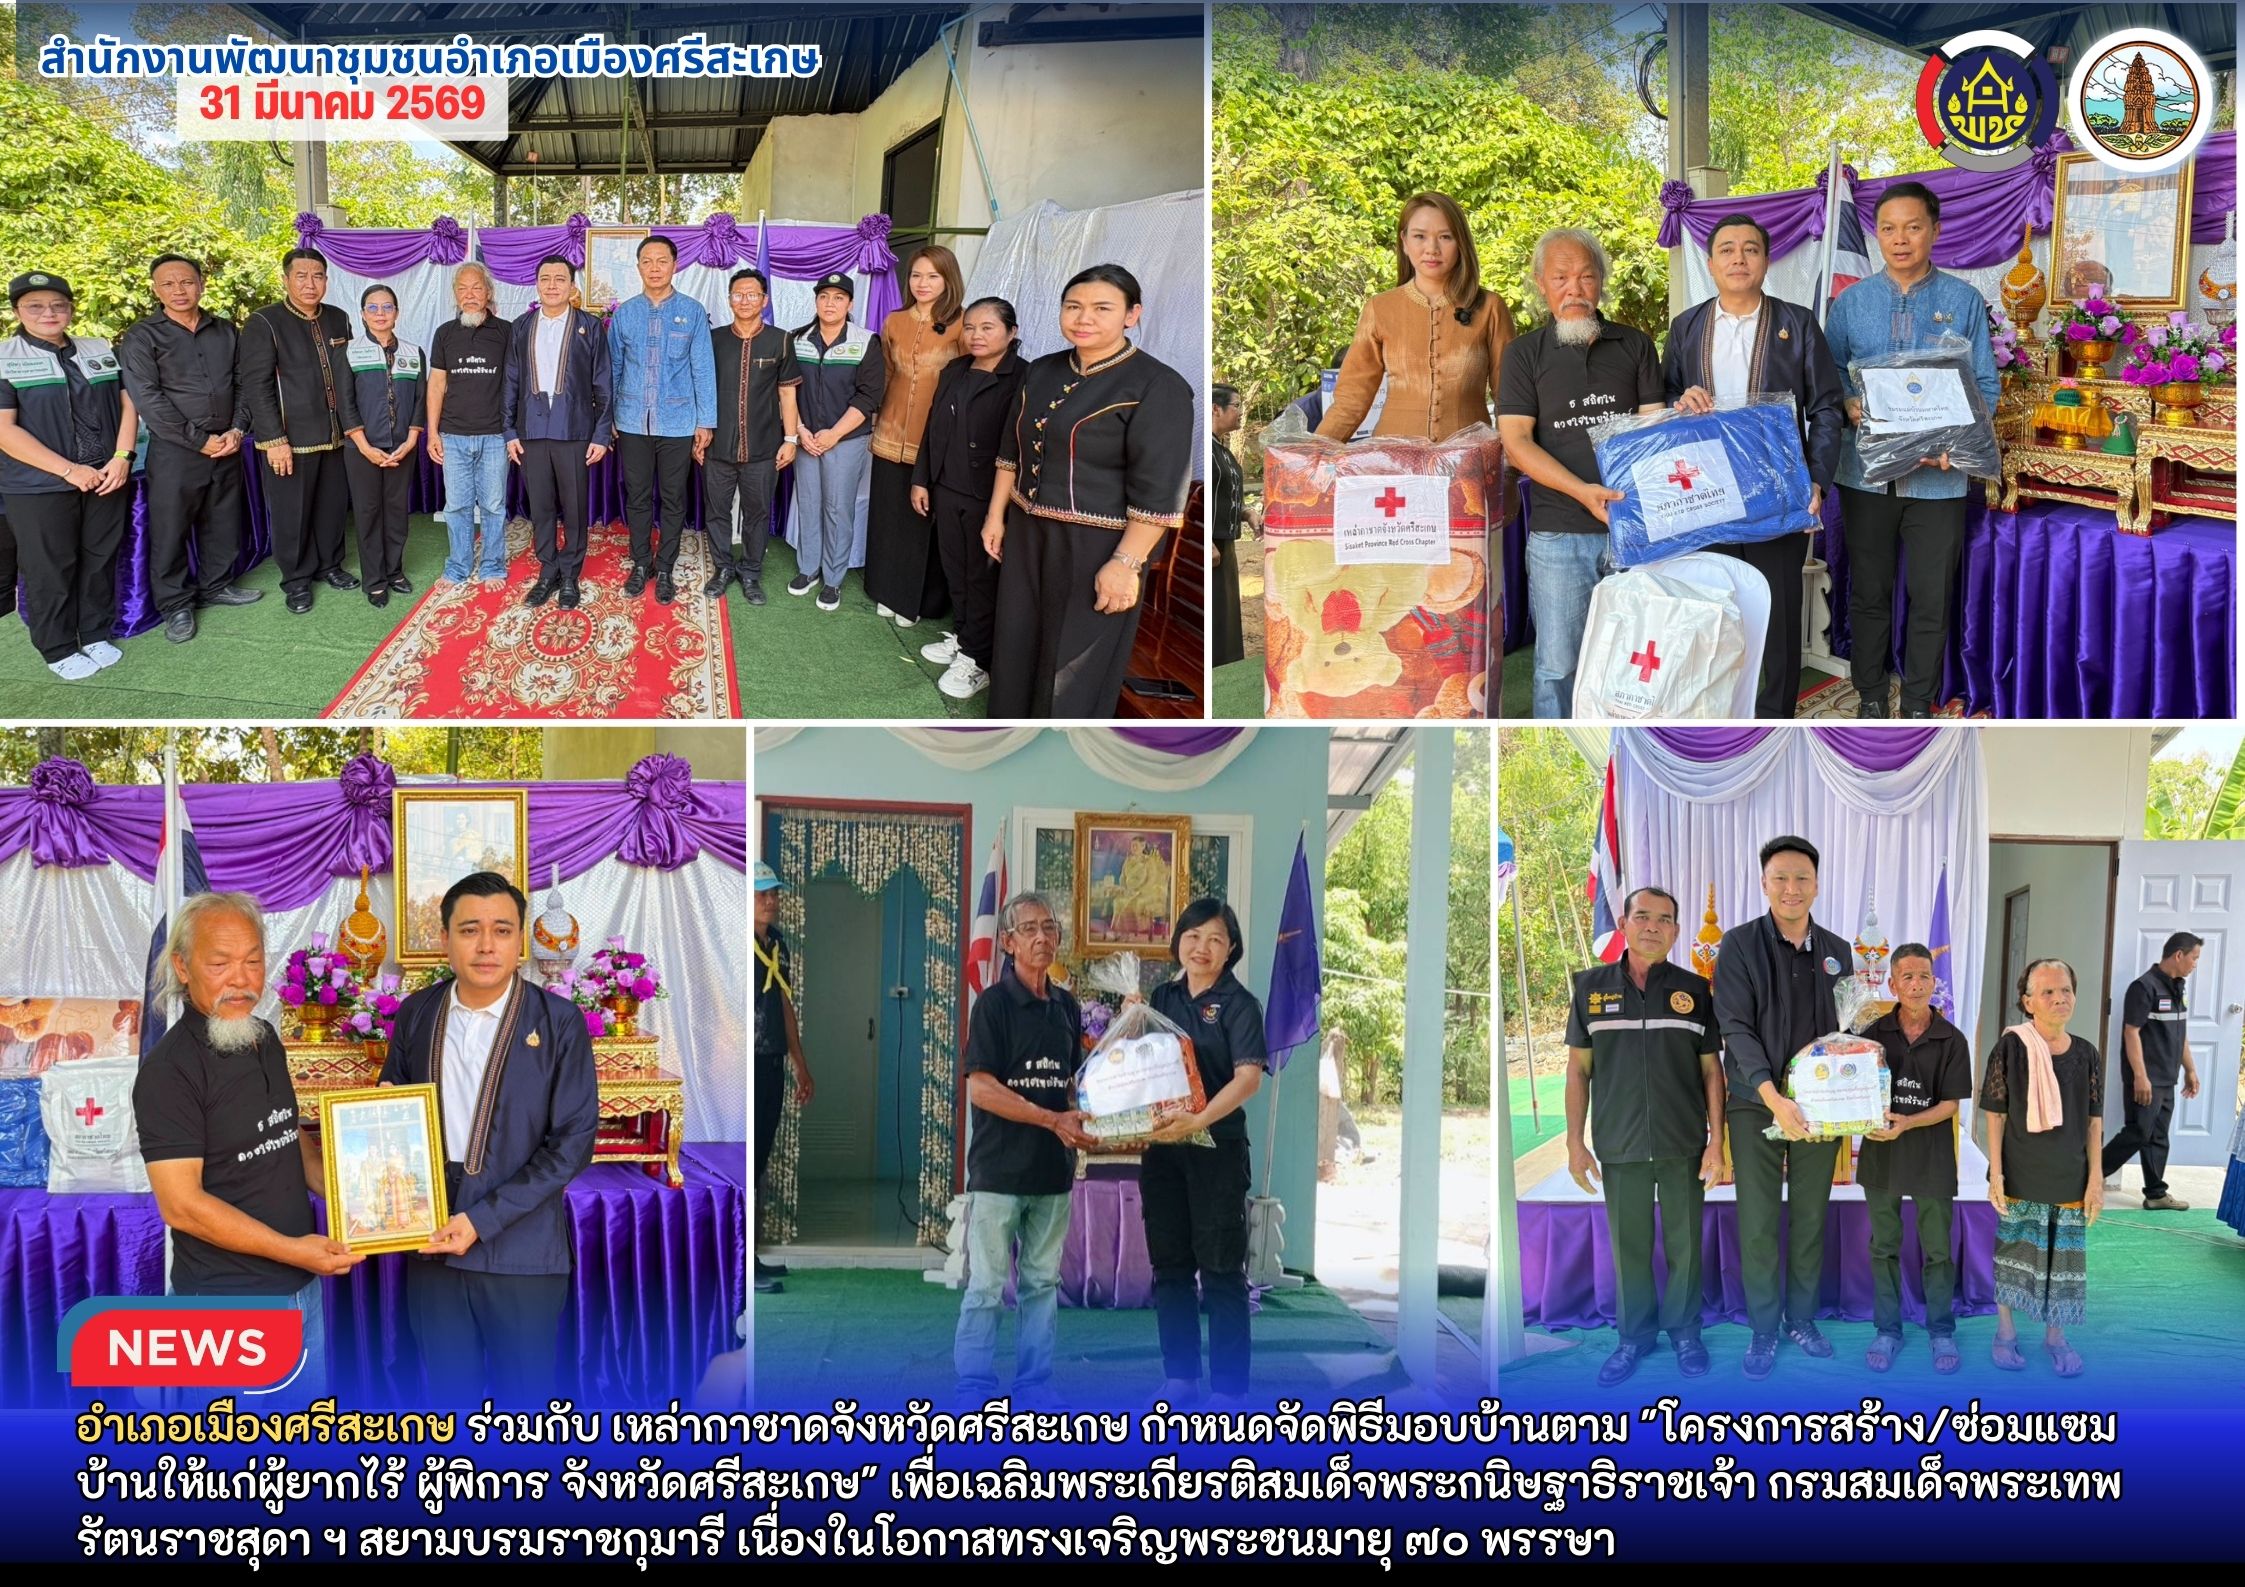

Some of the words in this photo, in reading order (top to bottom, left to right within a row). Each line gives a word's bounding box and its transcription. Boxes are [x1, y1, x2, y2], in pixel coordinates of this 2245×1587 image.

[1582, 393, 1616, 406] สถิตใน
[1343, 521, 1437, 537] เหล่ากาชาดจังหวัดศรีสะเกษ
[1364, 540, 1388, 548] Province
[1399, 538, 1414, 546] Cross
[1415, 538, 1436, 547] Chapter
